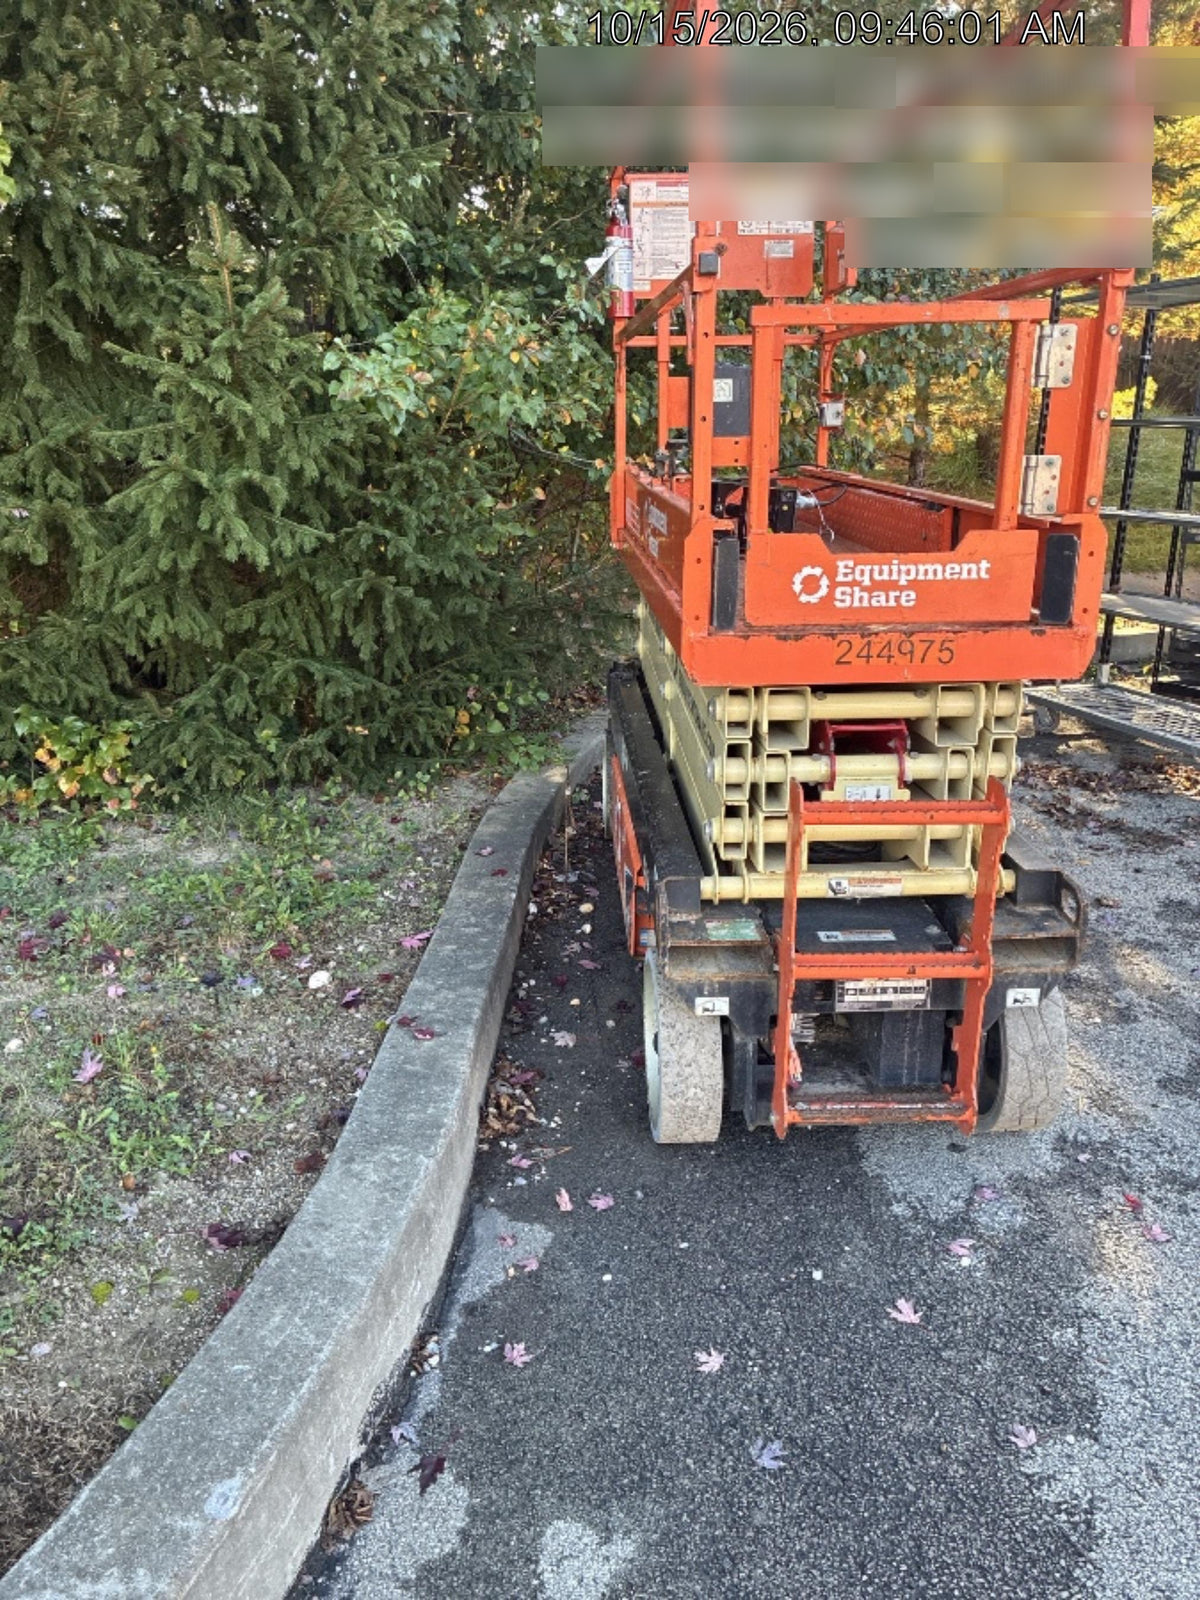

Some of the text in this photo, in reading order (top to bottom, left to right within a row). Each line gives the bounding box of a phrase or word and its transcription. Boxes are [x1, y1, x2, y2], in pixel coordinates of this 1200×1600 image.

[836, 559, 991, 586] Equipment
[834, 586, 917, 608] Share
[835, 639, 955, 665] 244975
